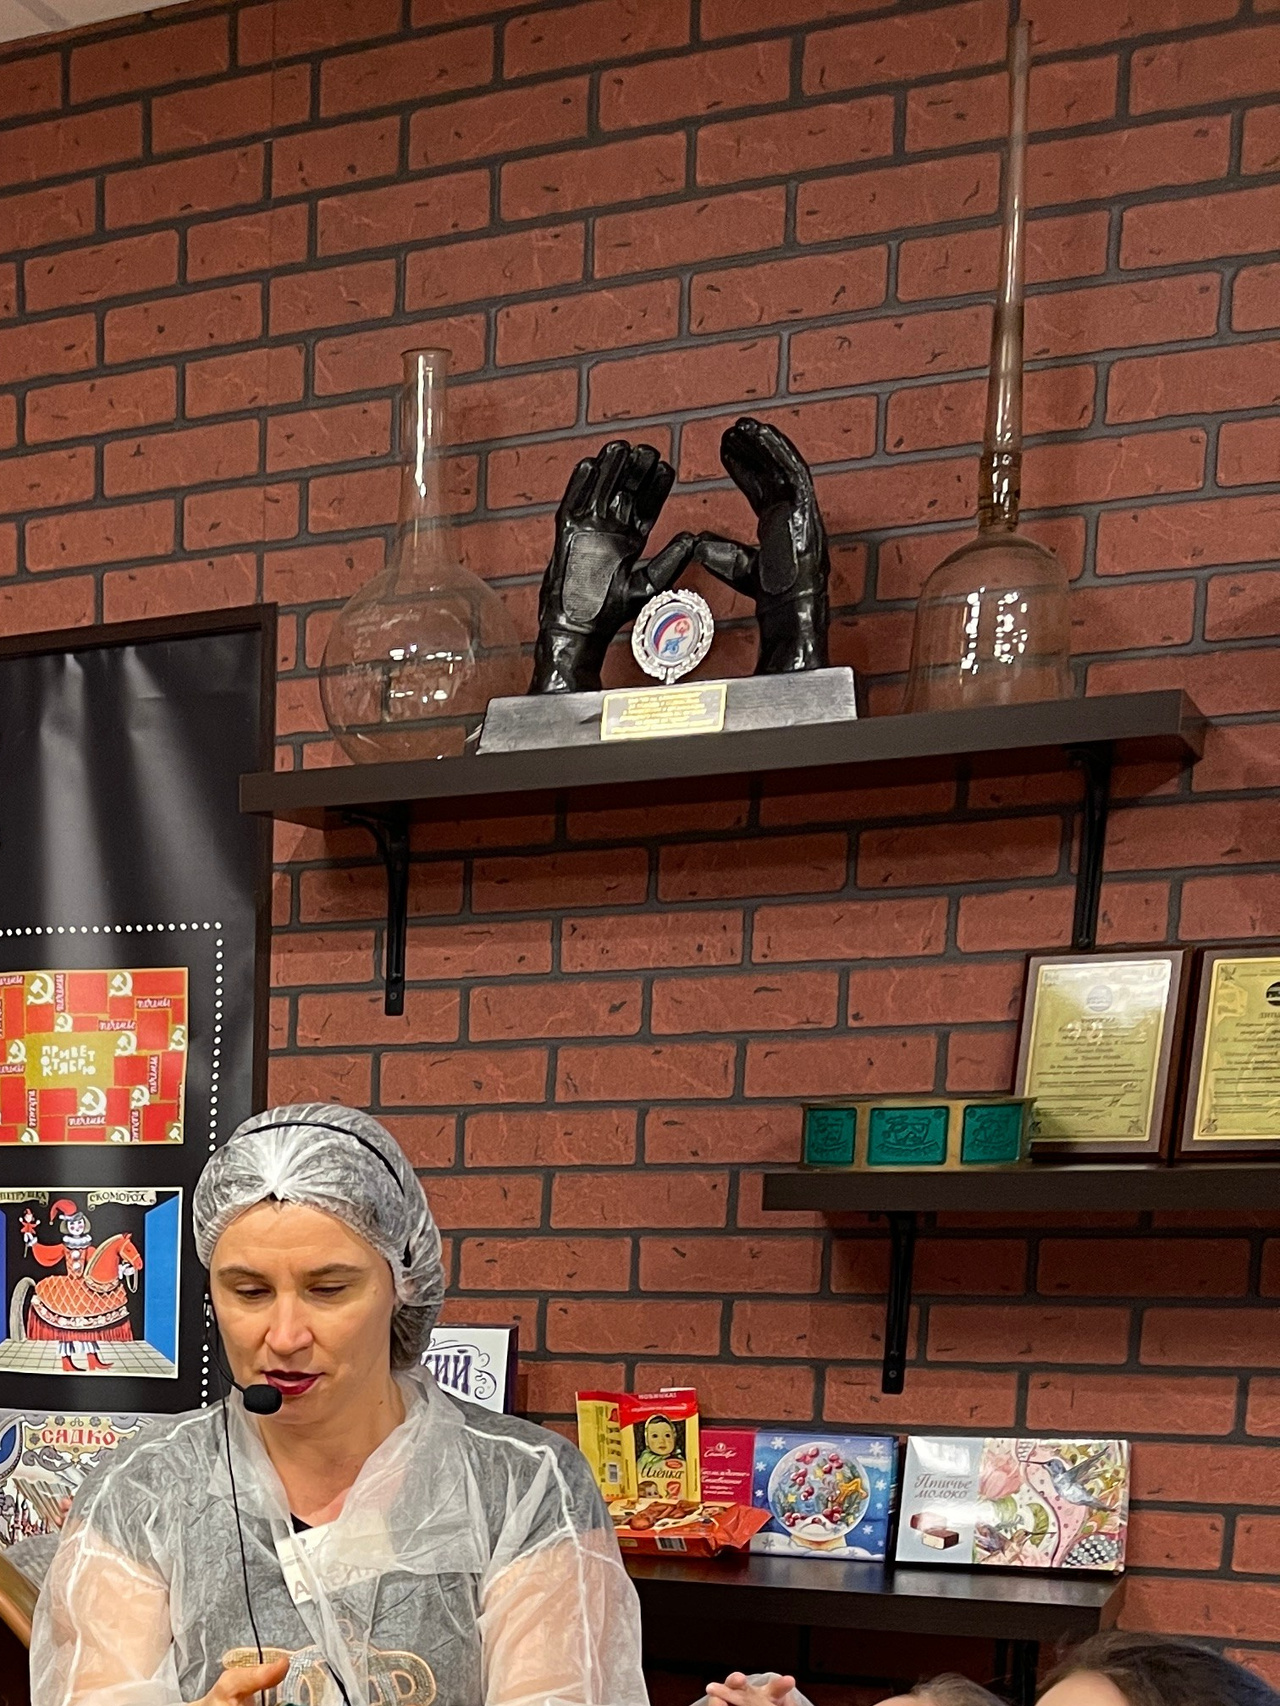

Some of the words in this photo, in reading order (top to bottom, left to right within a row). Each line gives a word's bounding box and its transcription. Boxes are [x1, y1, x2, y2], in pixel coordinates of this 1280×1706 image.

[41, 1044, 96, 1062] ПРИВЕТ
[89, 1190, 145, 1202] СКОМОРОХ
[41, 1428, 116, 1446] САДКО
[914, 1473, 973, 1490] Птичье
[914, 1488, 969, 1499] молоко
